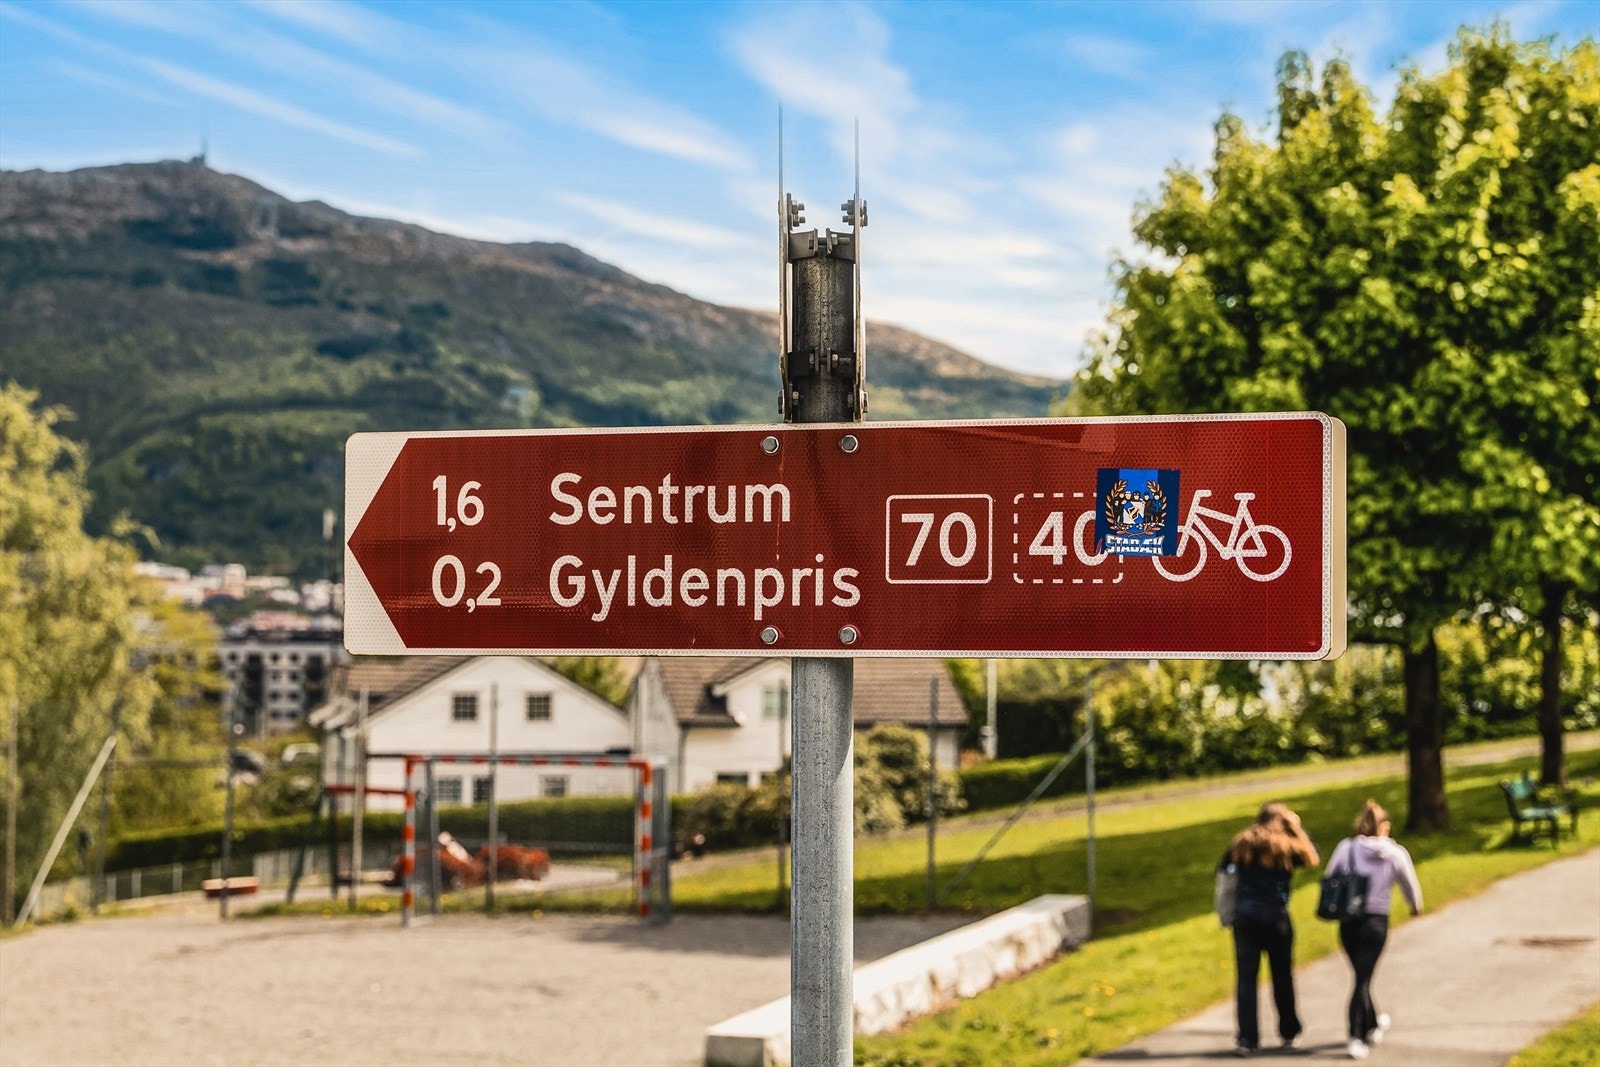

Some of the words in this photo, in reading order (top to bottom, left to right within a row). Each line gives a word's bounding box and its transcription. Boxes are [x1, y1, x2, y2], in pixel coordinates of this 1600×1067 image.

[432, 474, 485, 533] 1,6
[549, 472, 791, 525] Sentrum
[902, 512, 977, 567] 70
[431, 554, 502, 613] 0,2
[549, 553, 861, 622] Gyldenpris
